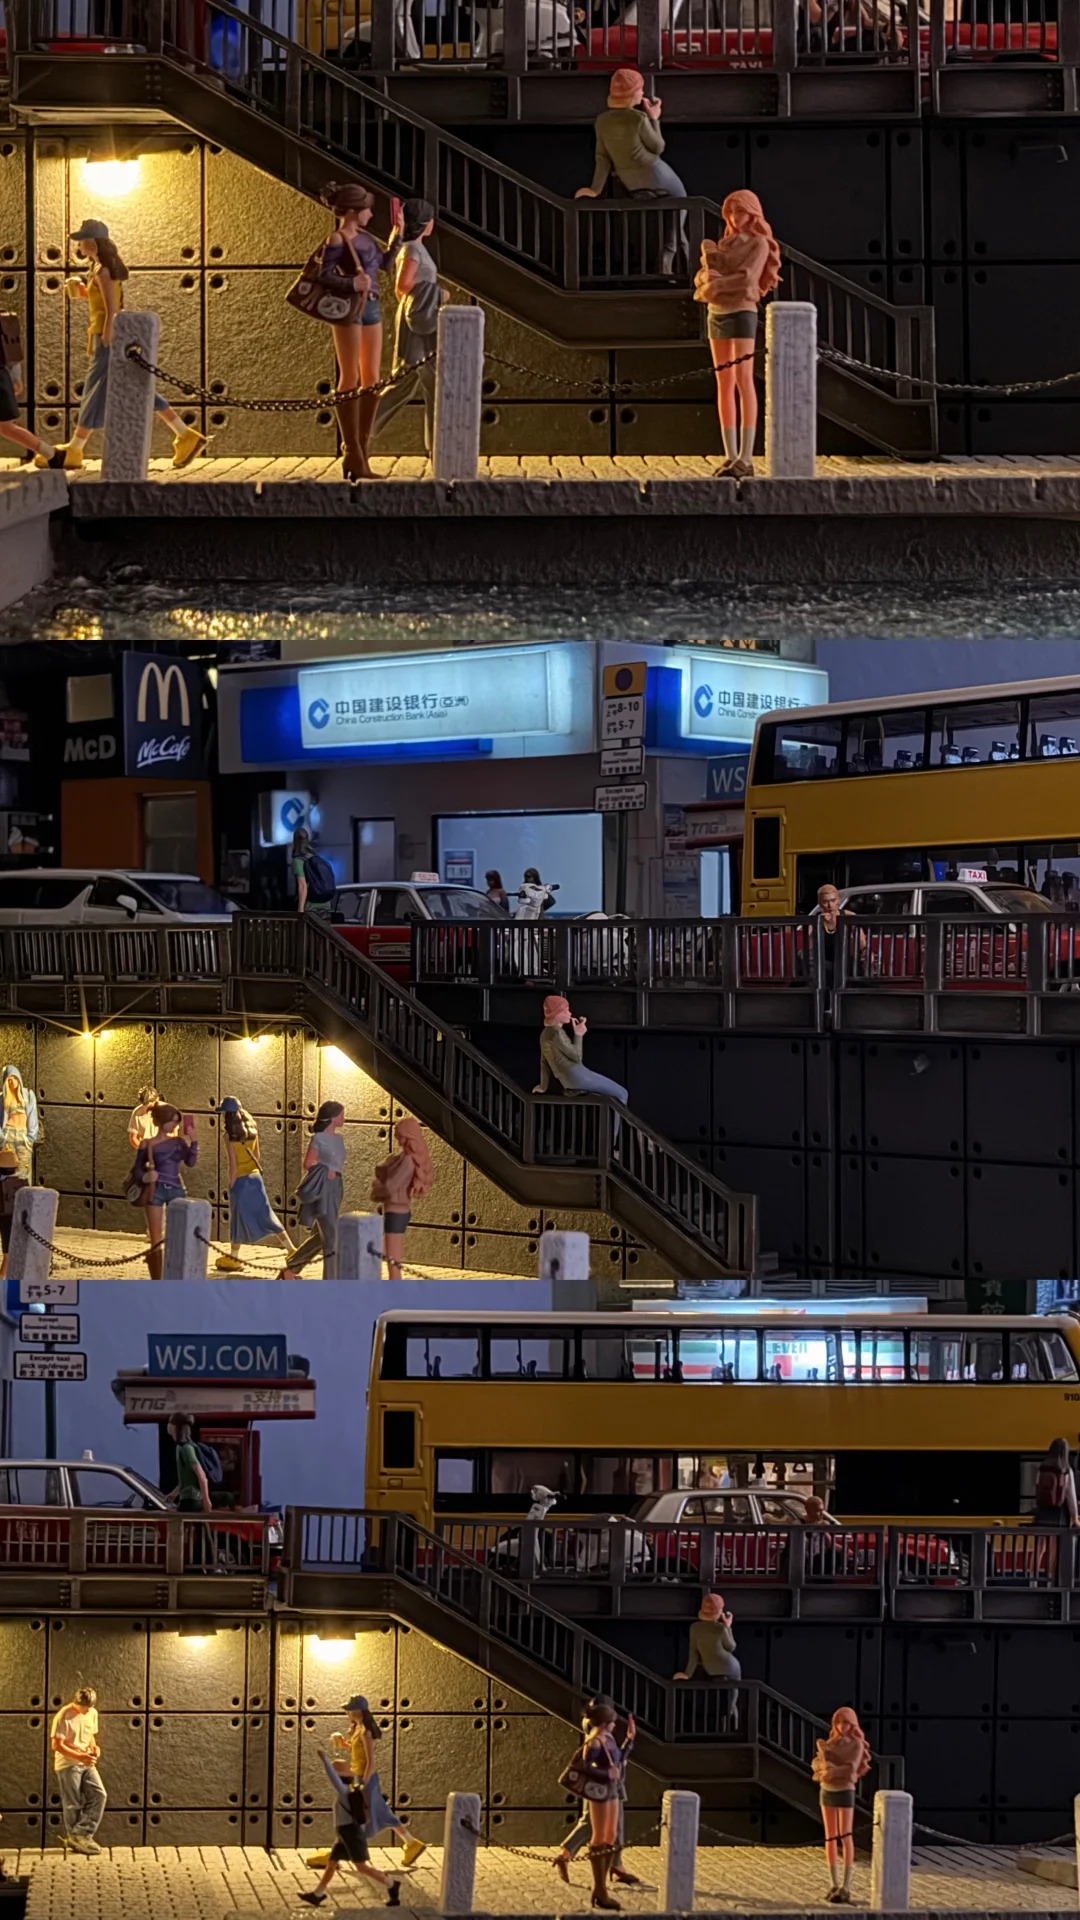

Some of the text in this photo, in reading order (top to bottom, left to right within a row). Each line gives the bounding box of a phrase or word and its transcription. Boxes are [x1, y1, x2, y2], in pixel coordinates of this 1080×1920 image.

[718, 690, 810, 709] 中国建设银行
[617, 700, 640, 712] 8-10
[336, 715, 357, 726] China
[359, 713, 404, 724] Construction
[405, 711, 425, 721] Bank
[718, 707, 758, 719] China Constr
[618, 719, 635, 731] 5-7
[63, 735, 116, 763] McD
[712, 766, 745, 794] WS
[967, 870, 986, 880] TAXI
[44, 1285, 65, 1296] 5-7
[155, 1344, 278, 1372] WSJ.COM
[1063, 1392, 1080, 1402] 910
